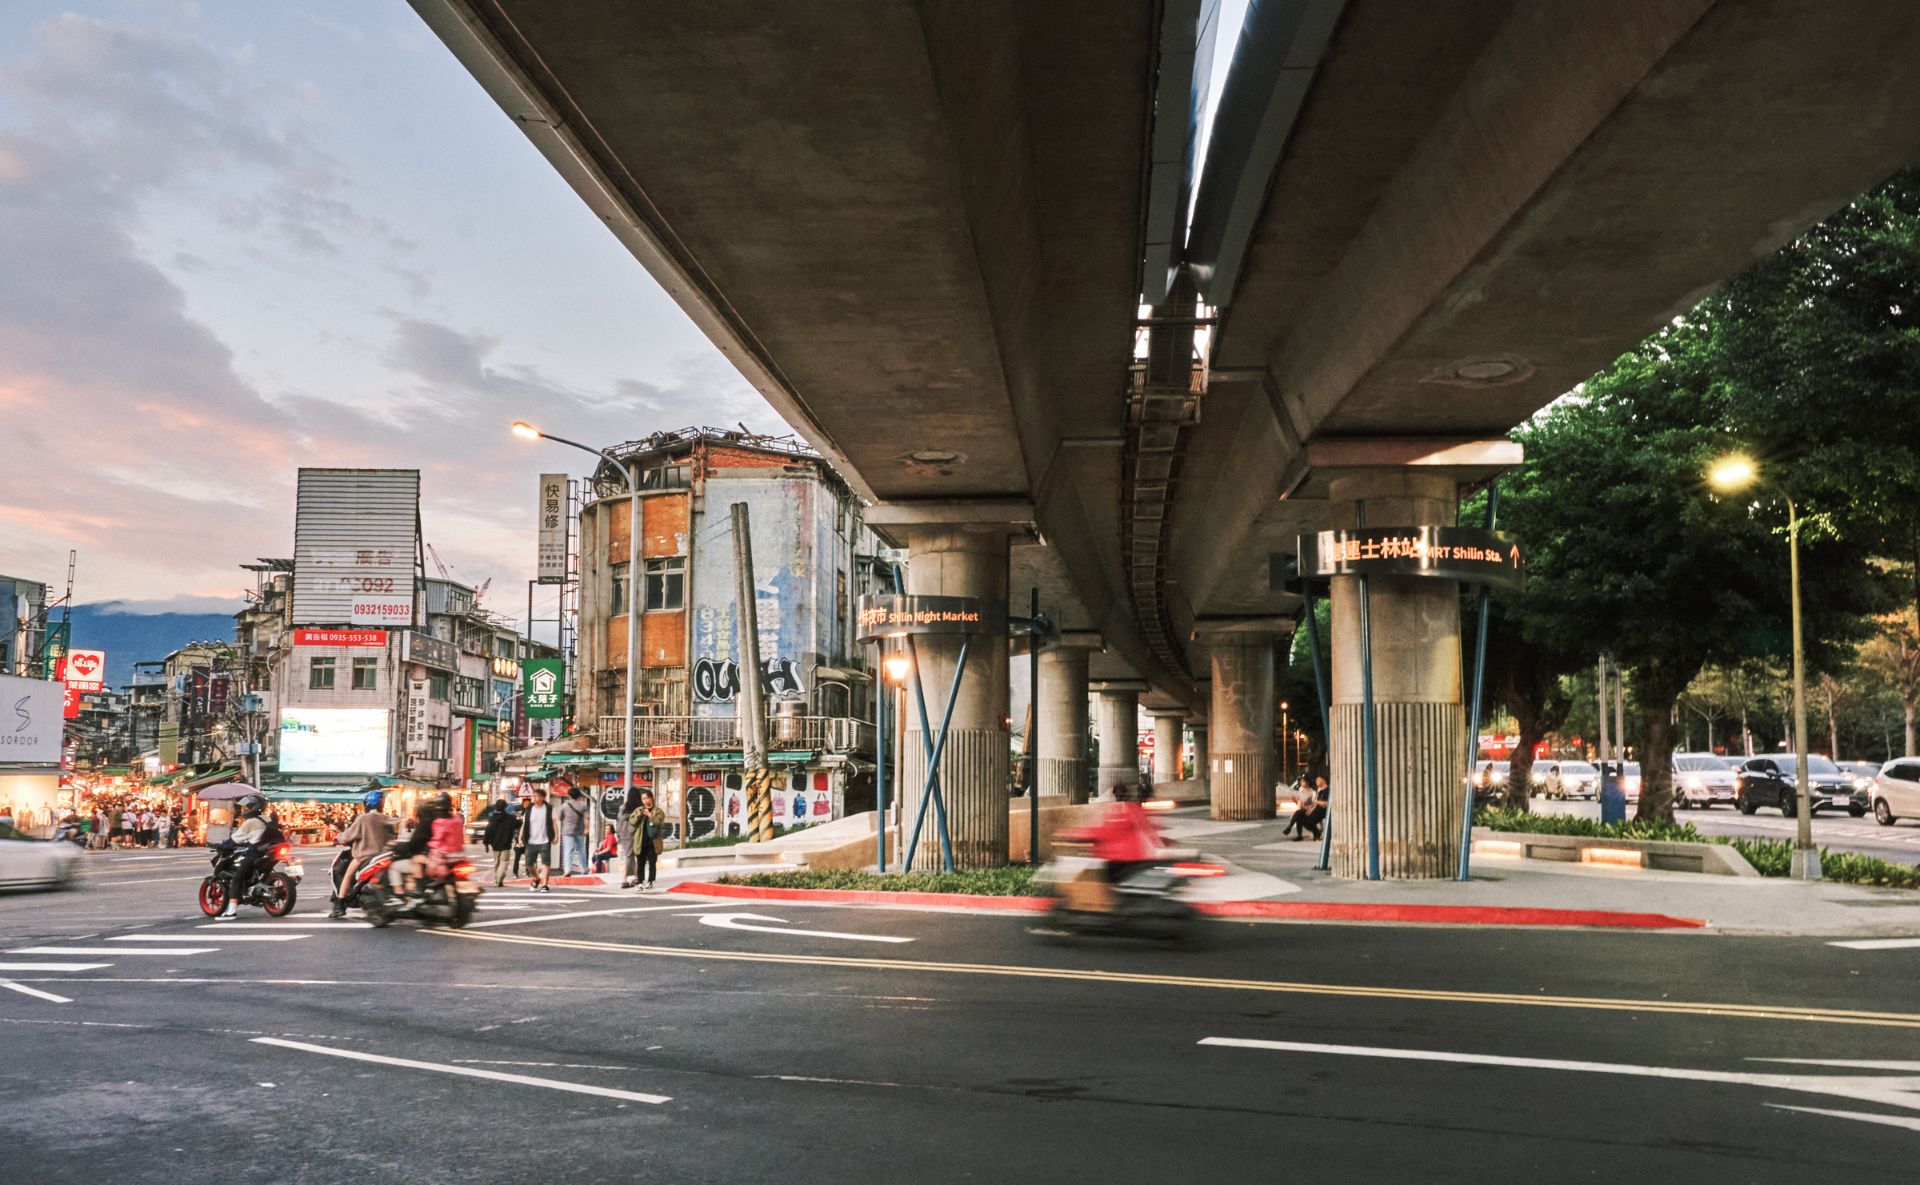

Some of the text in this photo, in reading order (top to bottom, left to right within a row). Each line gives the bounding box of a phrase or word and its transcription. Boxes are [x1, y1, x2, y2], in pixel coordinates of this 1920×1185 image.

[545, 484, 559, 528] 快易修
[1453, 546, 1484, 560] Shilin
[1485, 549, 1502, 562] Sta.
[354, 604, 410, 615] 0932159033
[914, 610, 941, 624] Night
[942, 611, 979, 622] Market
[329, 634, 377, 642] 0935-553-538
[527, 694, 558, 703] 大苑子
[0, 735, 38, 746] SOROOR
[1138, 735, 1155, 746] FC
